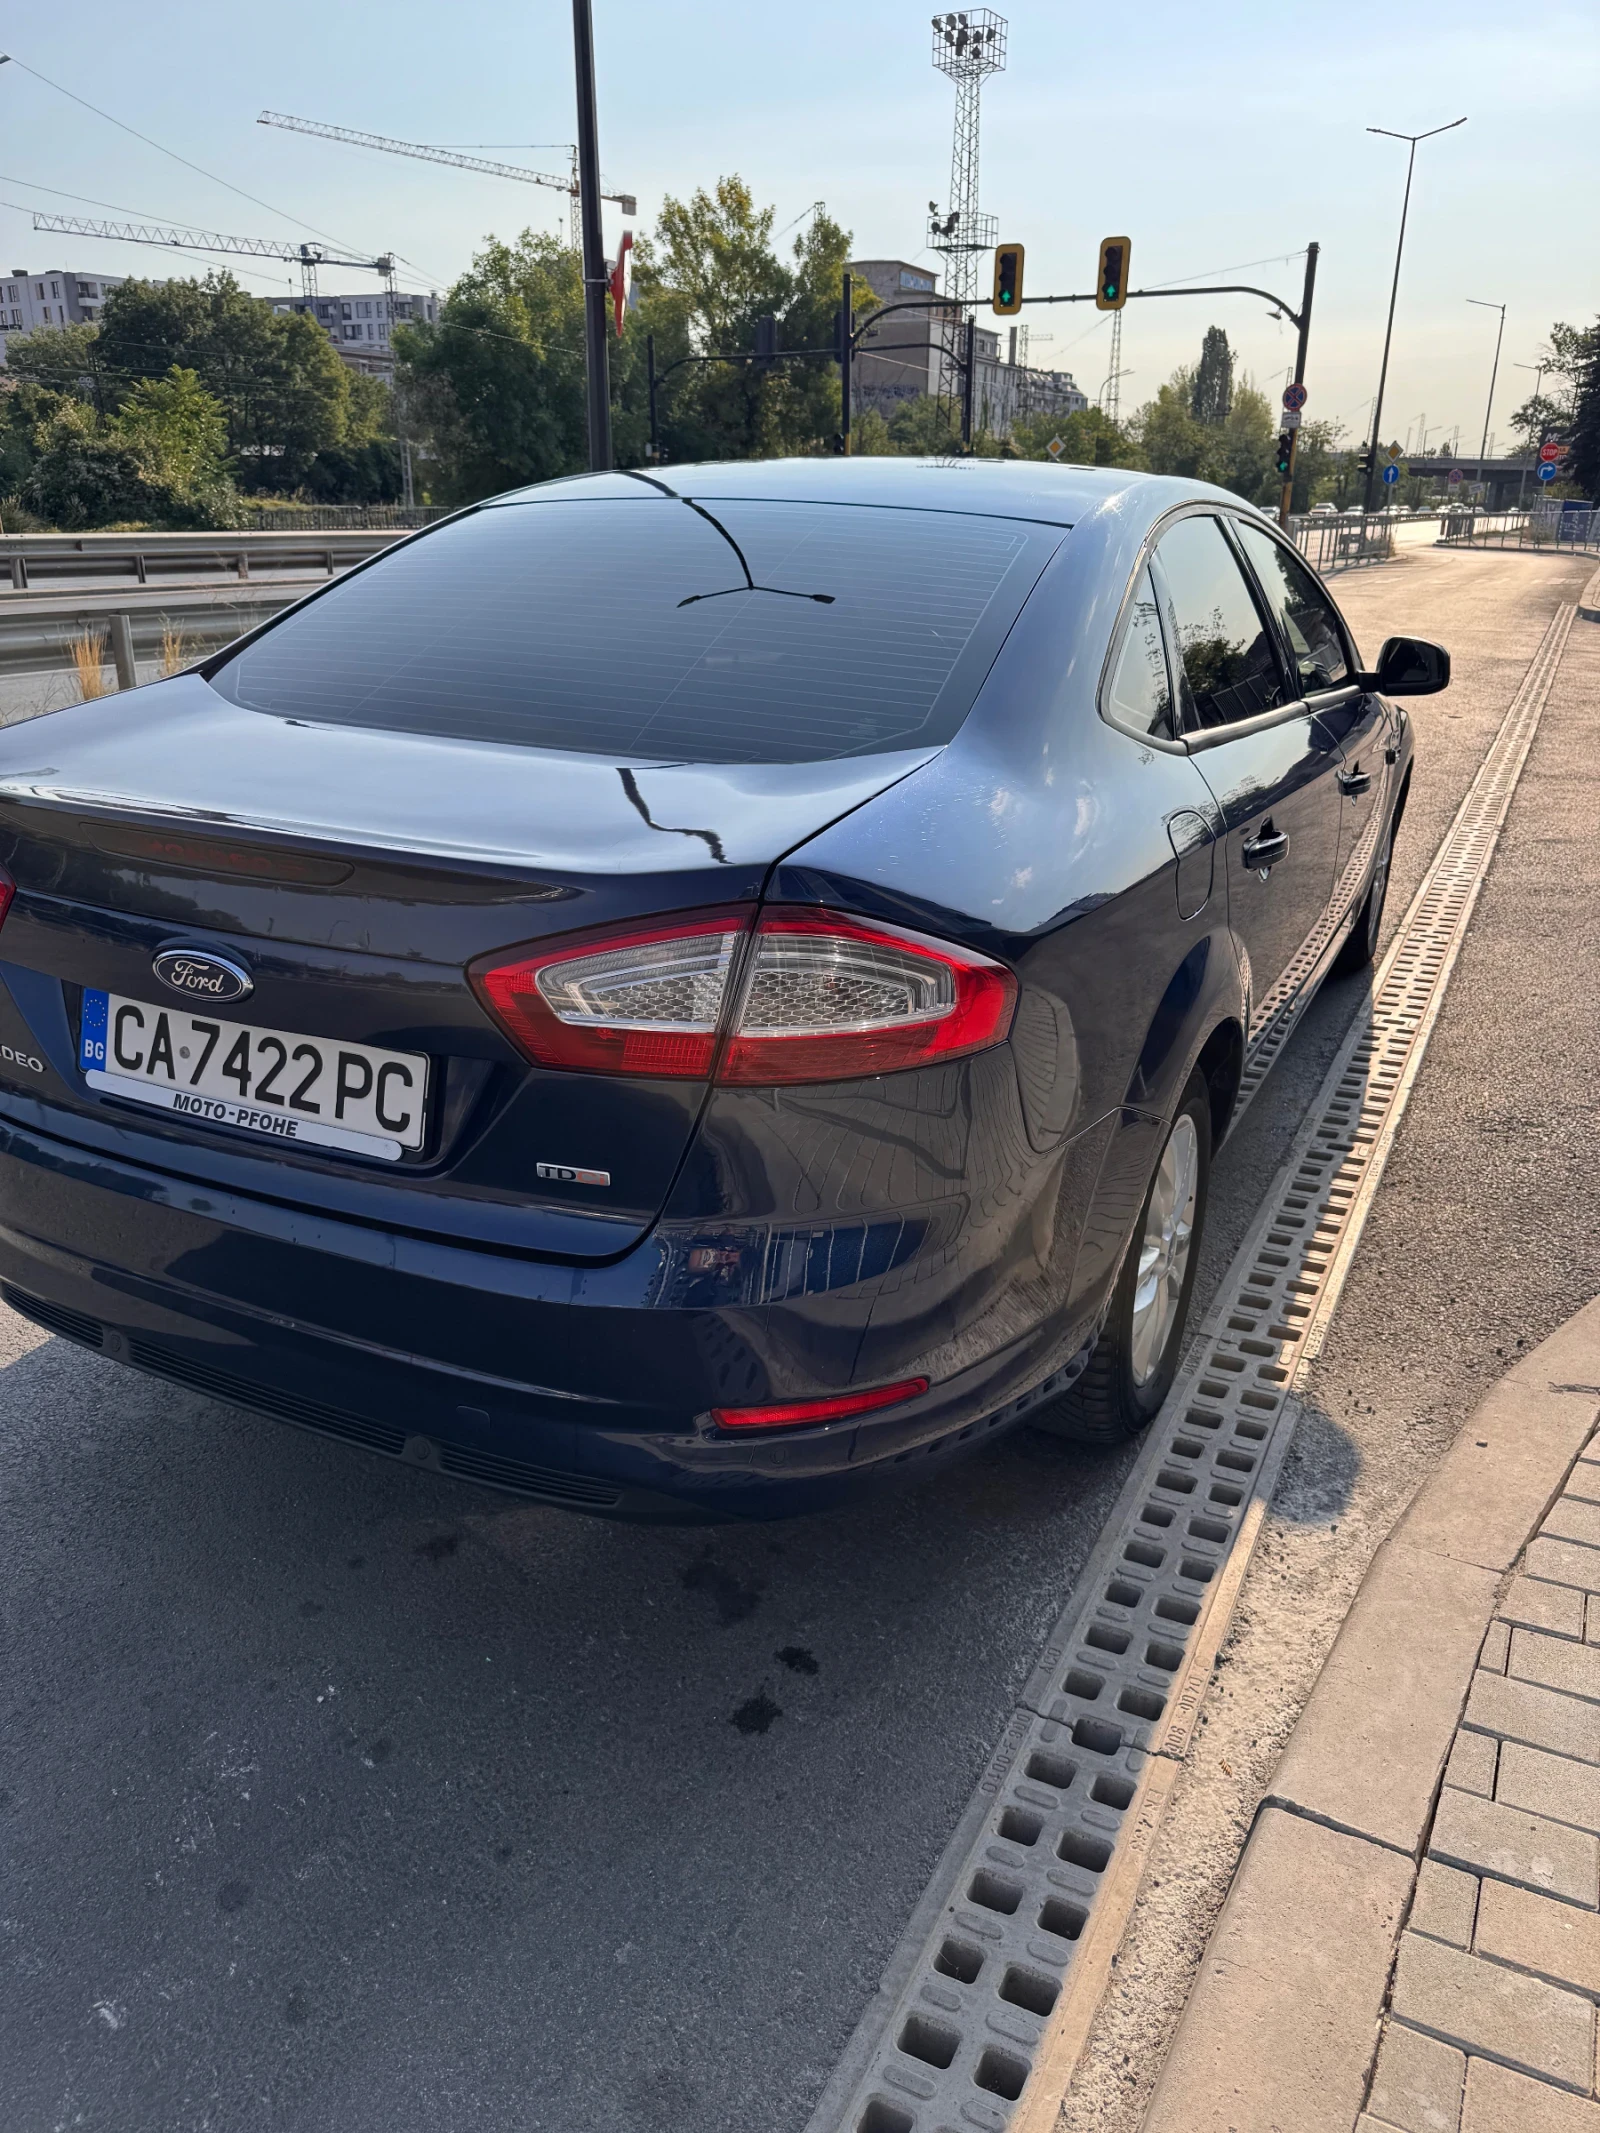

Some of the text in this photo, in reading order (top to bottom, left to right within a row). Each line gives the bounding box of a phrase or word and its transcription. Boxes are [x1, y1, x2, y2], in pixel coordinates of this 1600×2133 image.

[1542, 448, 1558, 456] STOP
[171, 959, 224, 994] Ford
[84, 1038, 104, 1061] BG
[114, 1004, 413, 1133] CA 7422 PC
[1039, 1647, 1062, 1674] ACO
